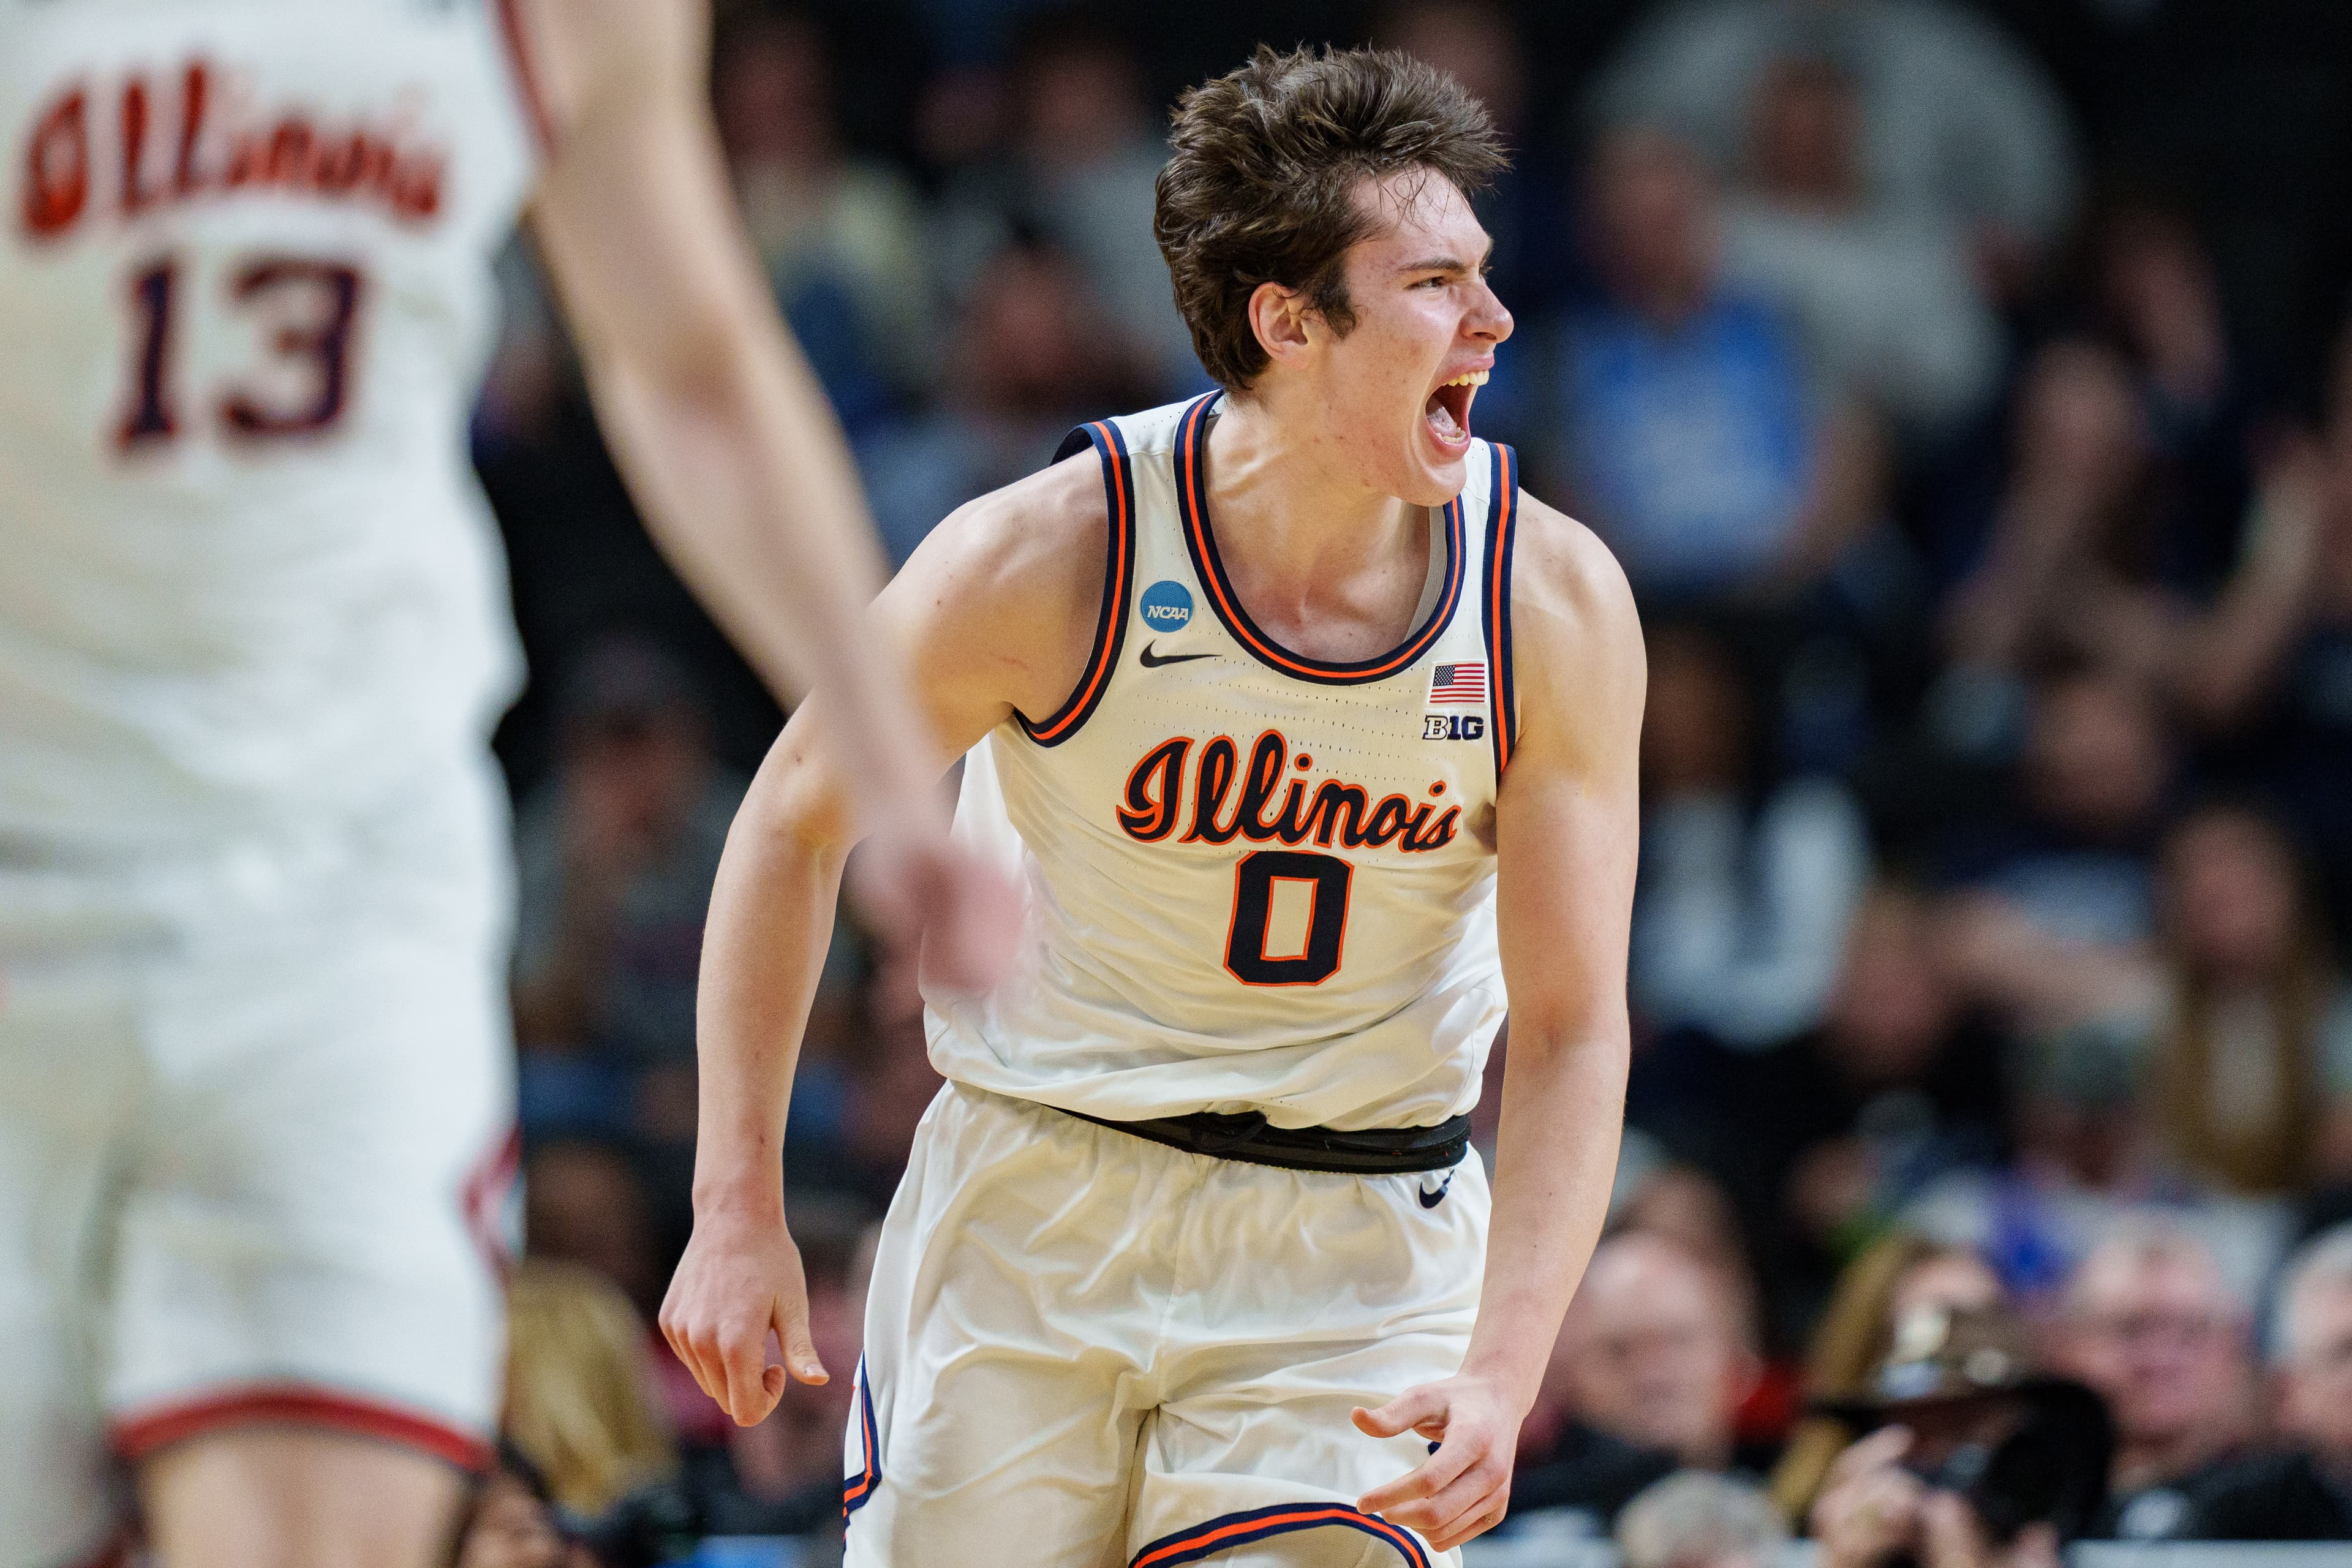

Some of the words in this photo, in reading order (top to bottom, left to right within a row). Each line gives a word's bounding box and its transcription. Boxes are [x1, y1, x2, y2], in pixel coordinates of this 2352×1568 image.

[112, 254, 363, 442] 13
[1147, 605, 1189, 620] NCAA
[1115, 729, 1461, 853] Illinois
[1224, 850, 1354, 987] 0
